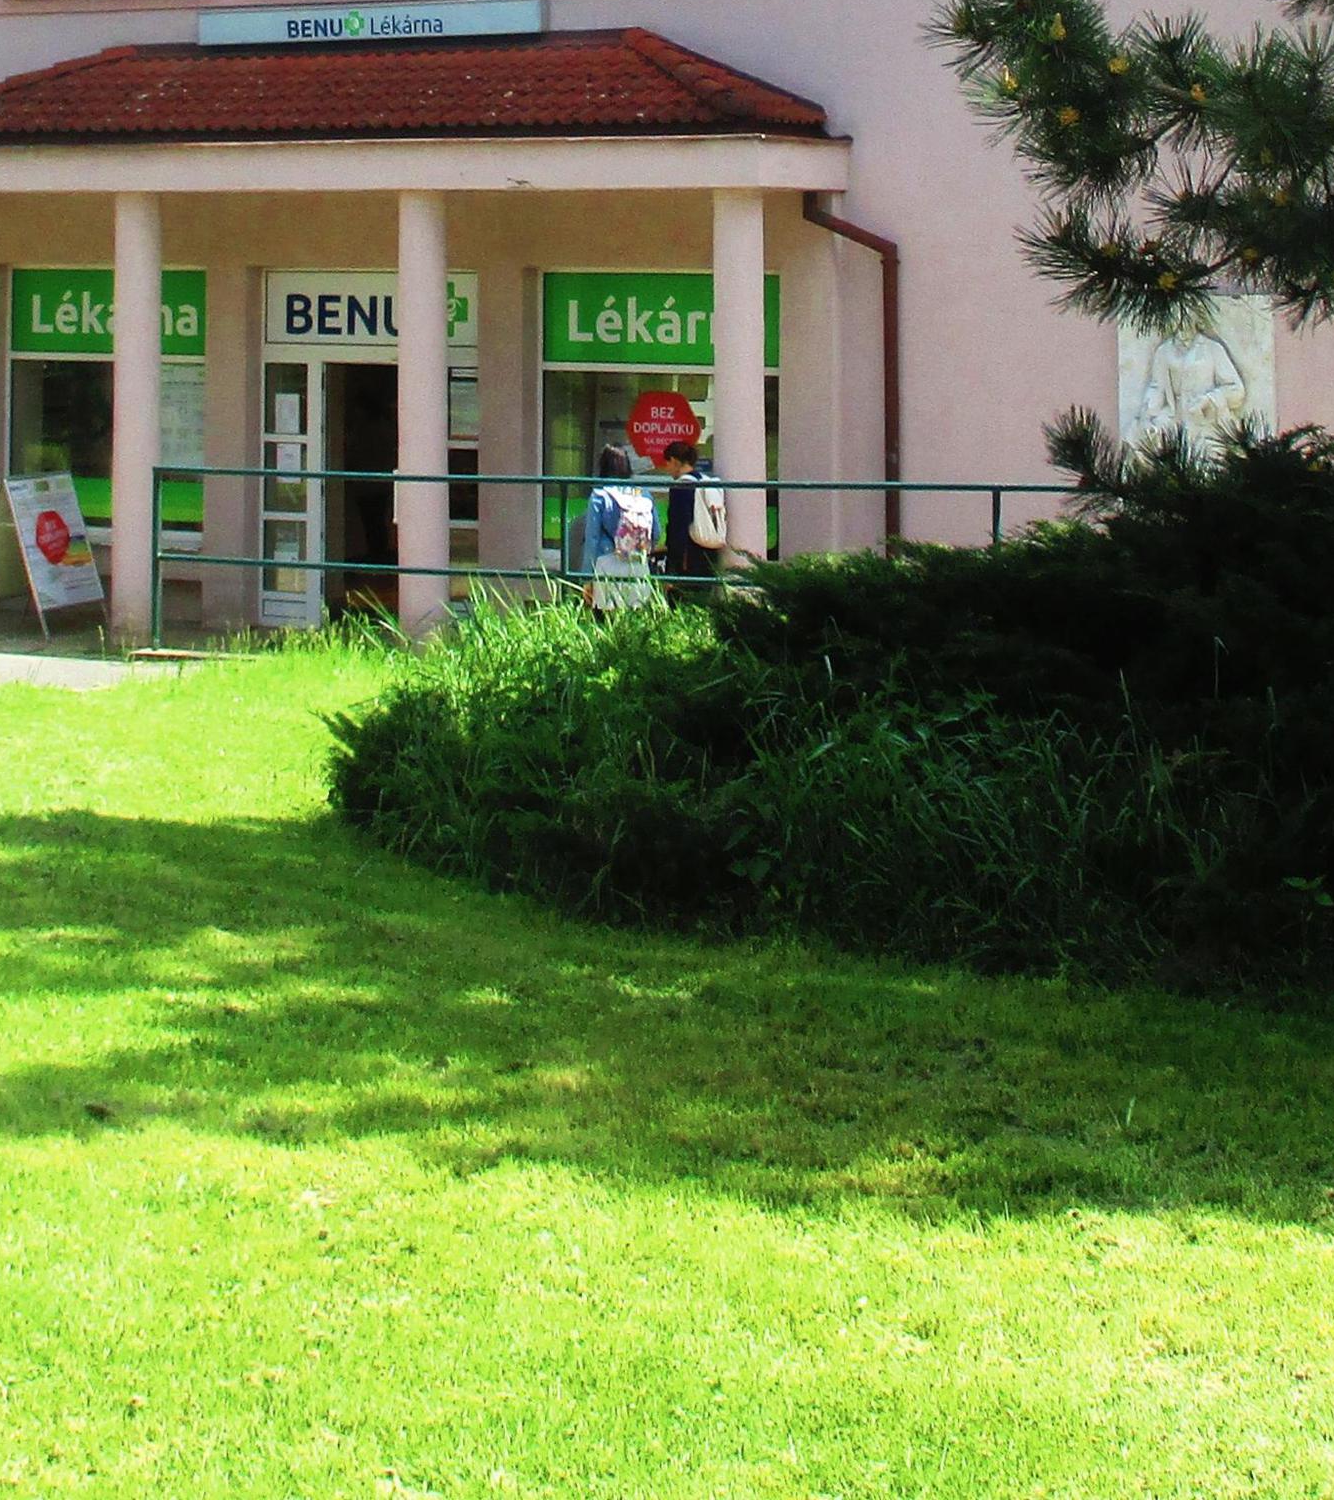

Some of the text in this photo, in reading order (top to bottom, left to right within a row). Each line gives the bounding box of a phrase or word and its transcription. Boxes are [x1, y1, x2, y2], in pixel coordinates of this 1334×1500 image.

[287, 14, 443, 38] BENU Lékárna
[31, 290, 199, 337] Lékna
[568, 295, 714, 344] Lékár
[651, 406, 675, 419] BEZ
[633, 421, 695, 436] DOPLATKU
